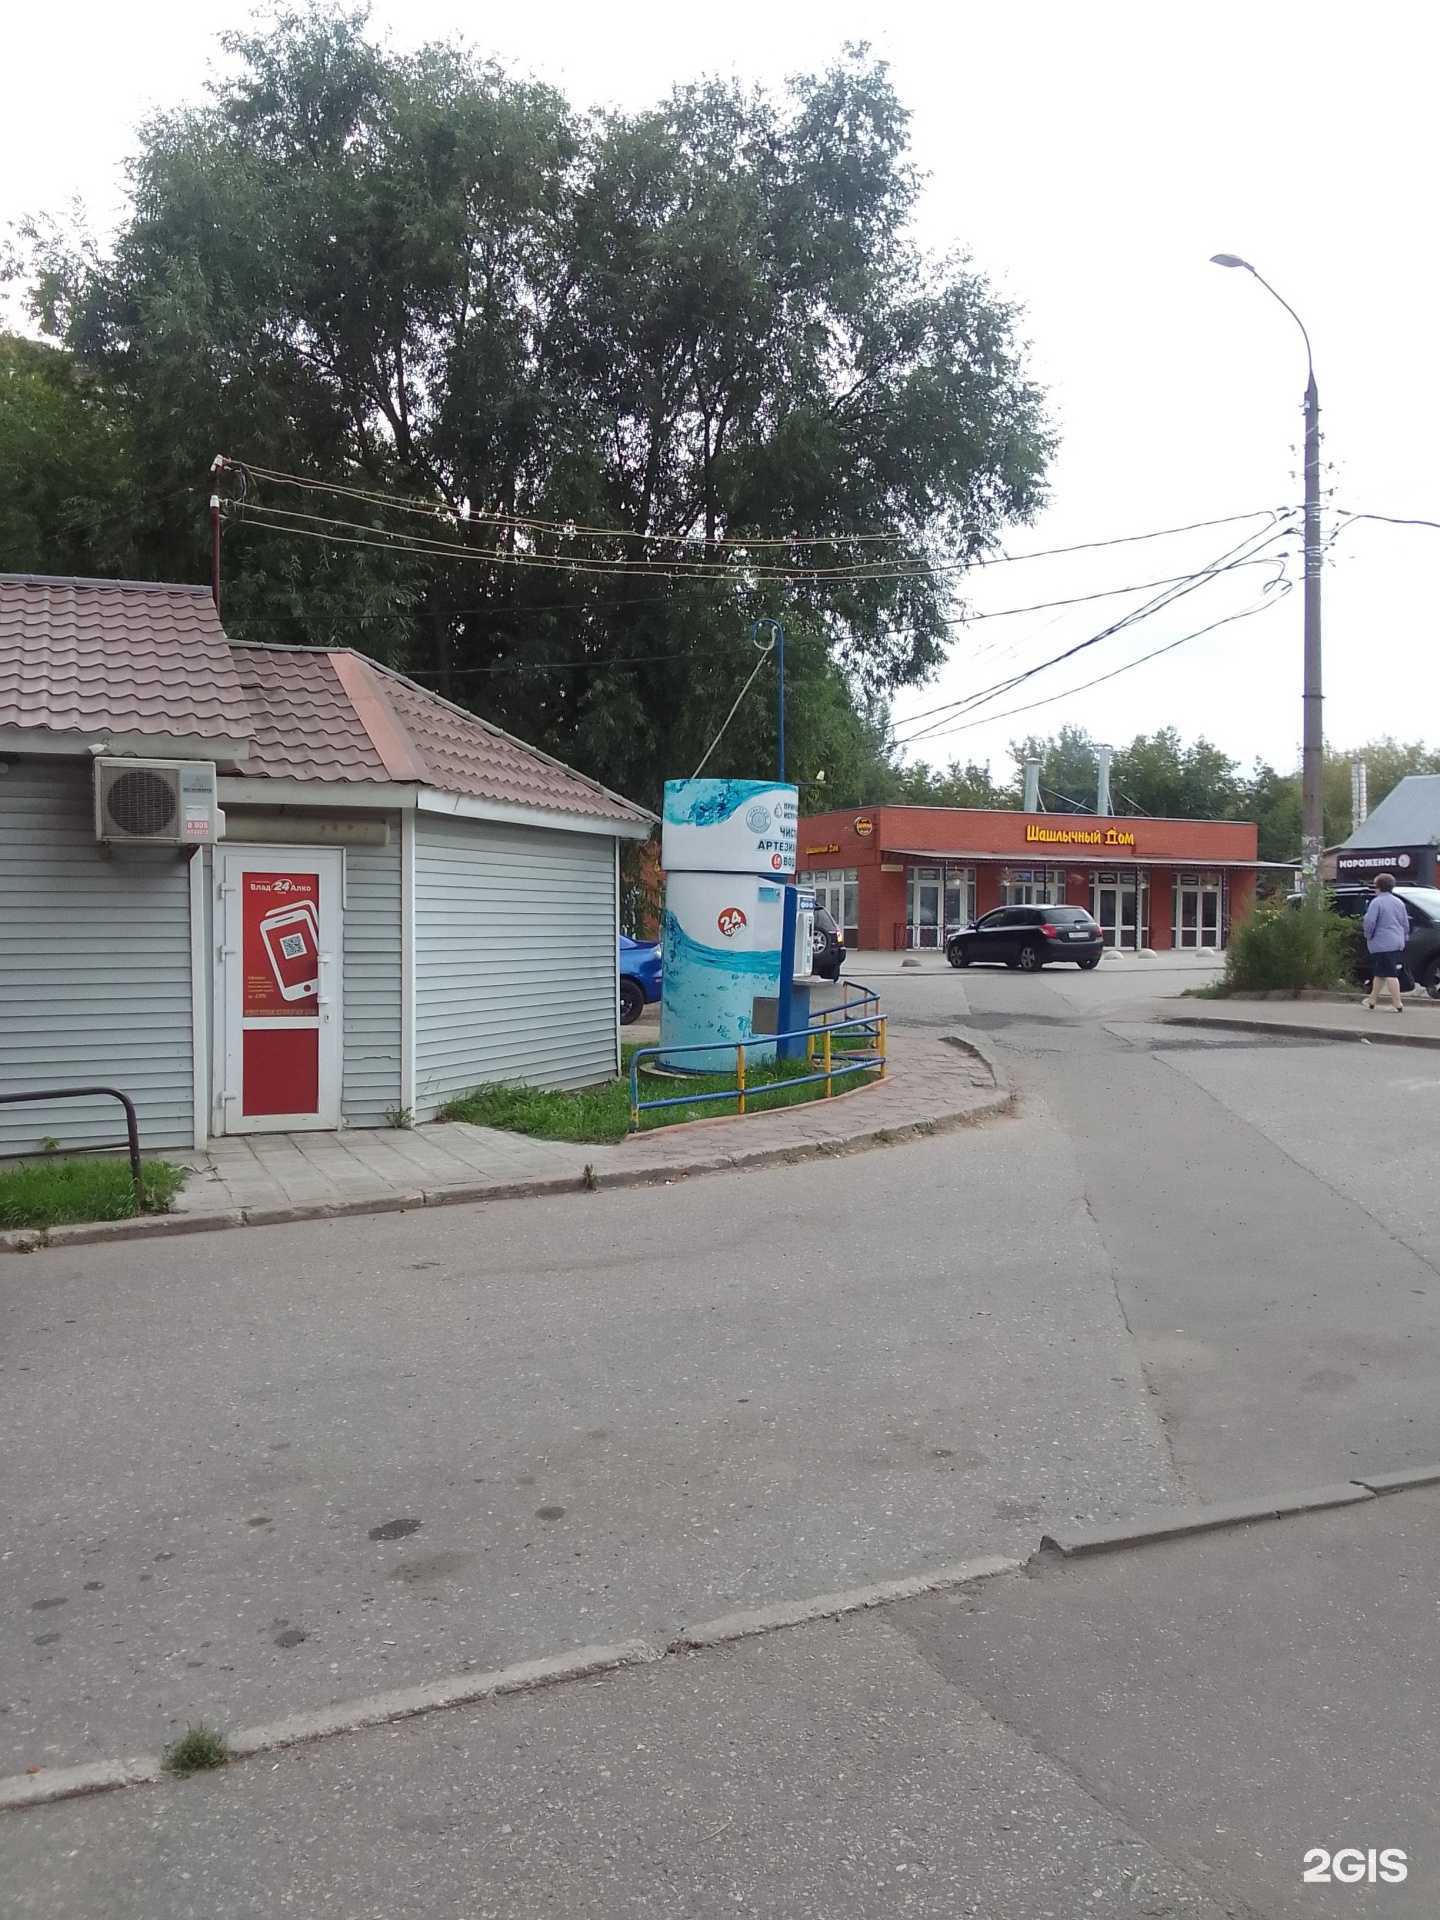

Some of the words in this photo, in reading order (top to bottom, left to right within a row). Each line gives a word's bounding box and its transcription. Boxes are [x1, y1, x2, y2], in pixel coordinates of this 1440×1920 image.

[1026, 824, 1101, 844] Шашлычный
[1104, 827, 1135, 845] Дом
[1339, 857, 1397, 868] МОРОЖЕНОЕ
[250, 883, 271, 892] Влад
[273, 880, 290, 891] 24
[290, 884, 312, 892] Алко
[720, 910, 742, 931] 24
